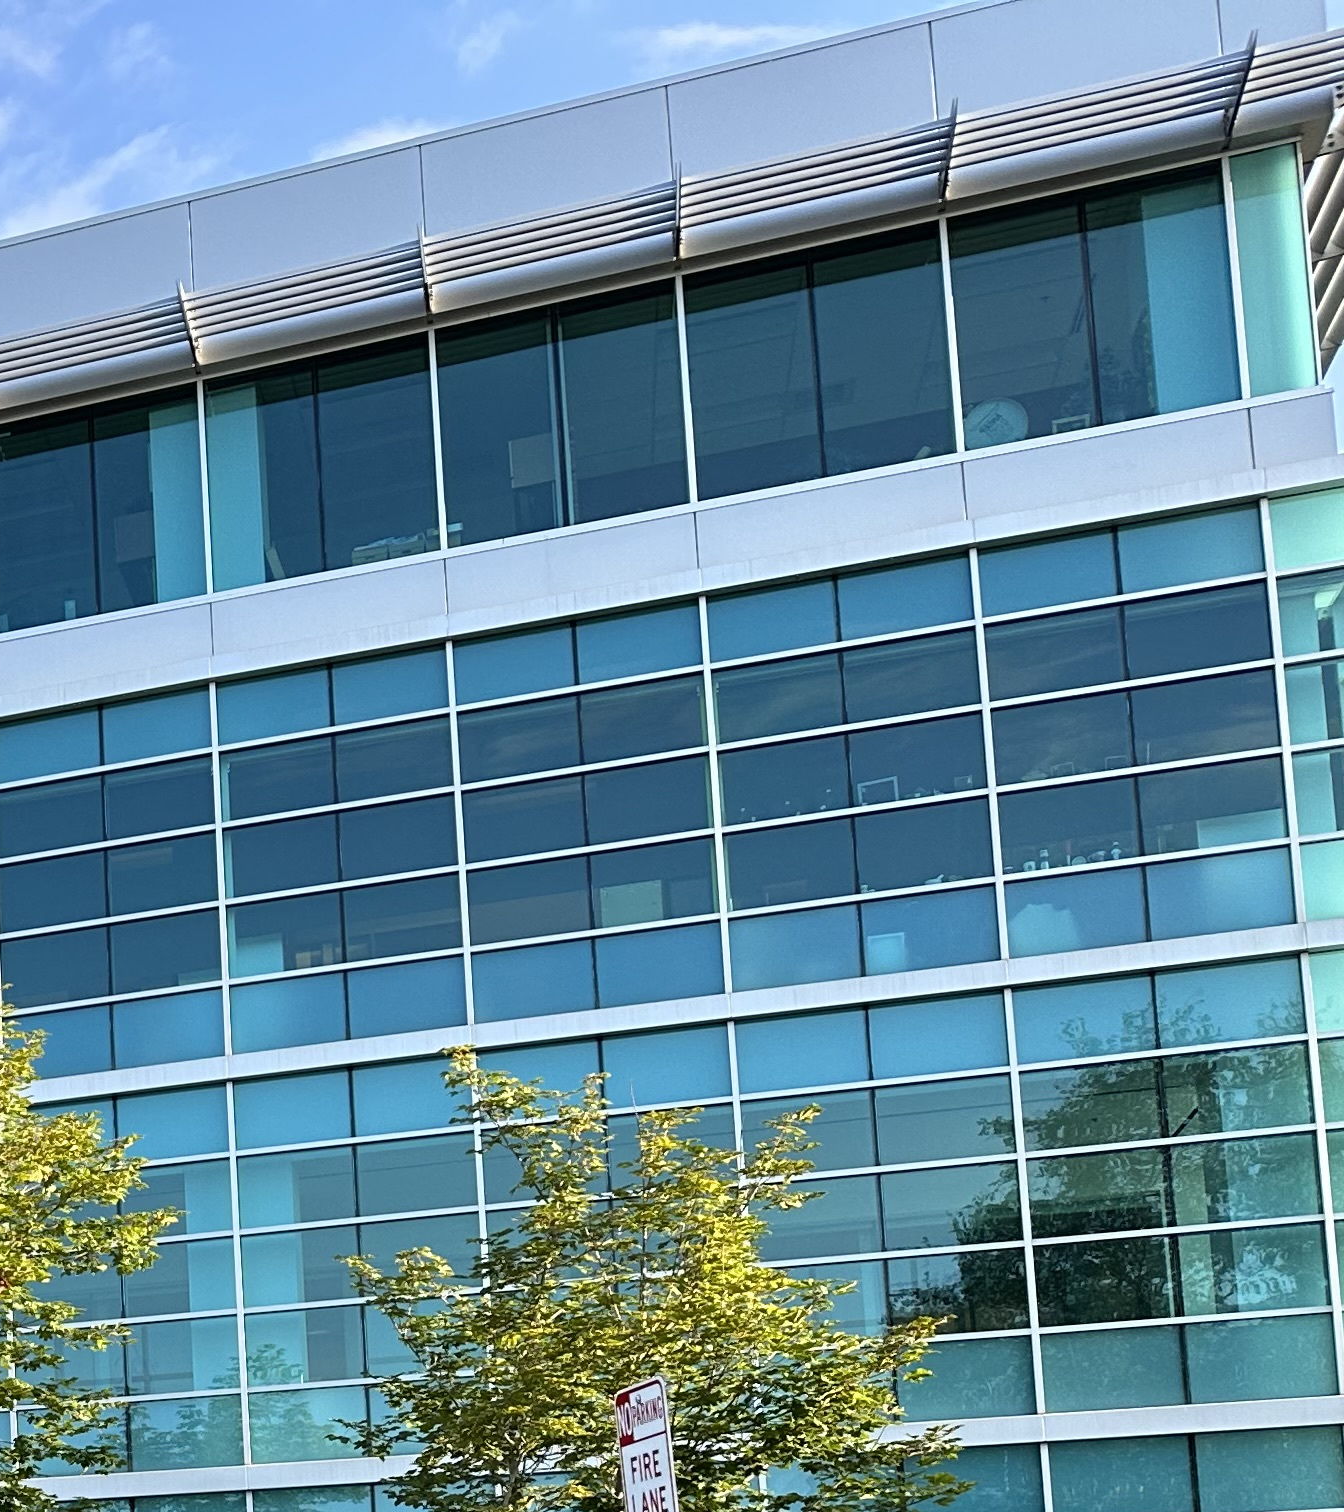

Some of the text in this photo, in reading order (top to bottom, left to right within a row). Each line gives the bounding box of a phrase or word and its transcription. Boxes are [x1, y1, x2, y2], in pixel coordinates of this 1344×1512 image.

[617, 1396, 663, 1438] NO PARKING
[630, 1449, 662, 1485] FIRE
